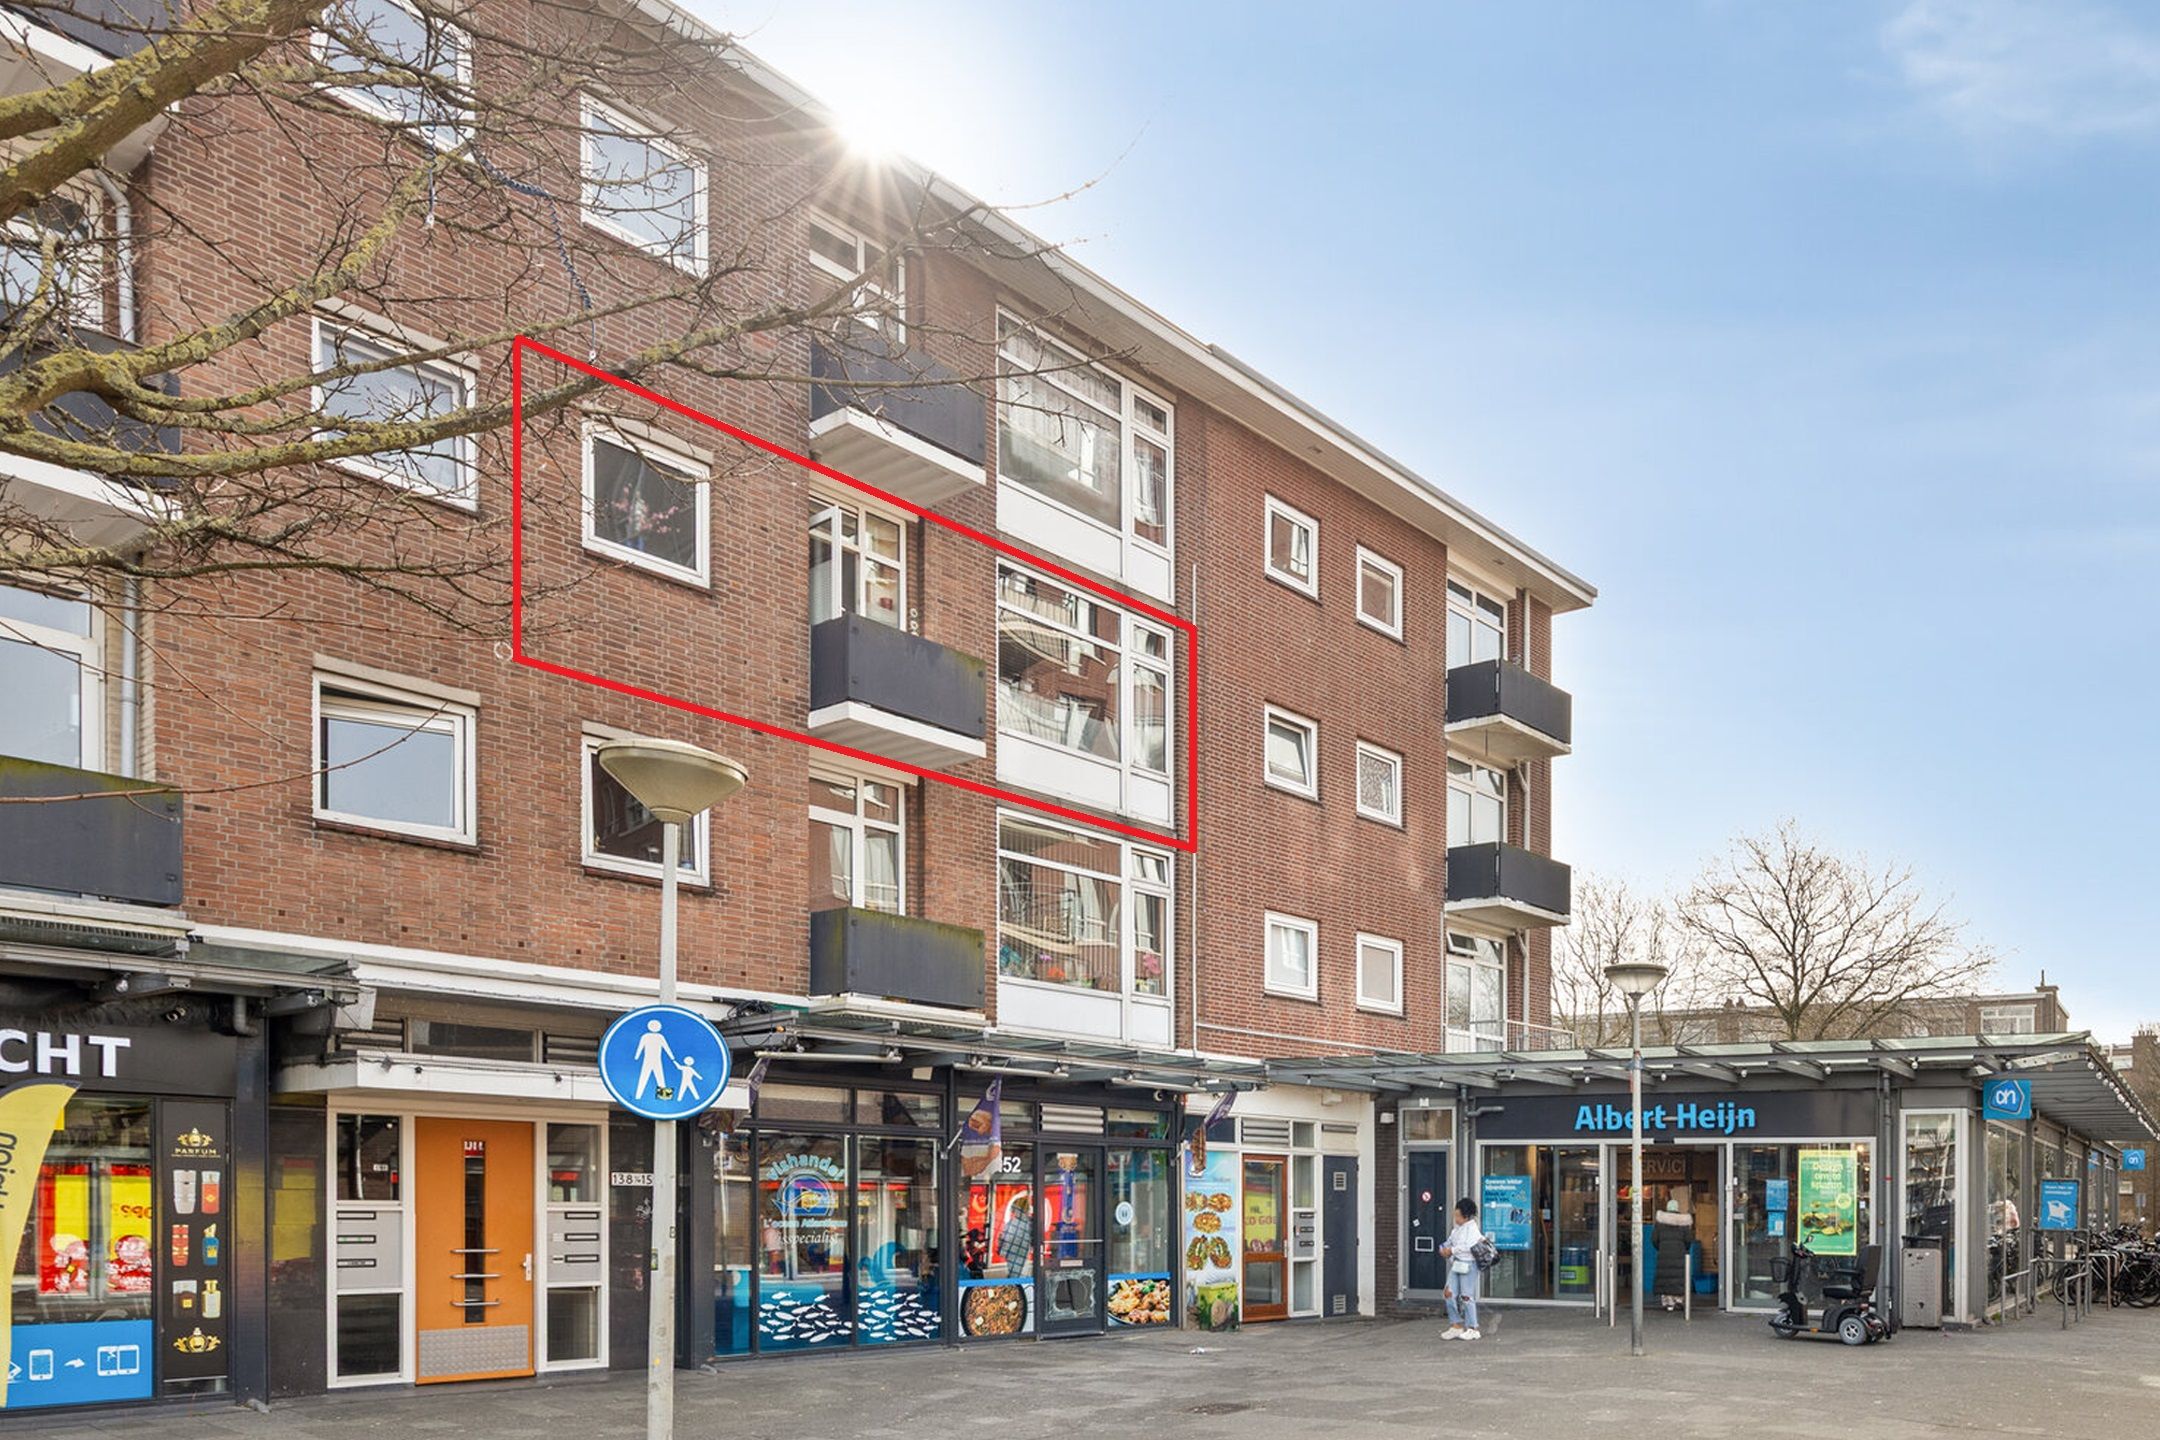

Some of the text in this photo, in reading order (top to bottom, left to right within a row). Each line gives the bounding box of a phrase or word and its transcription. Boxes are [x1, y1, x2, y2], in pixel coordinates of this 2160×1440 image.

[1574, 1102, 1756, 1135] Albert Heijn
[999, 1156, 1021, 1173] 52
